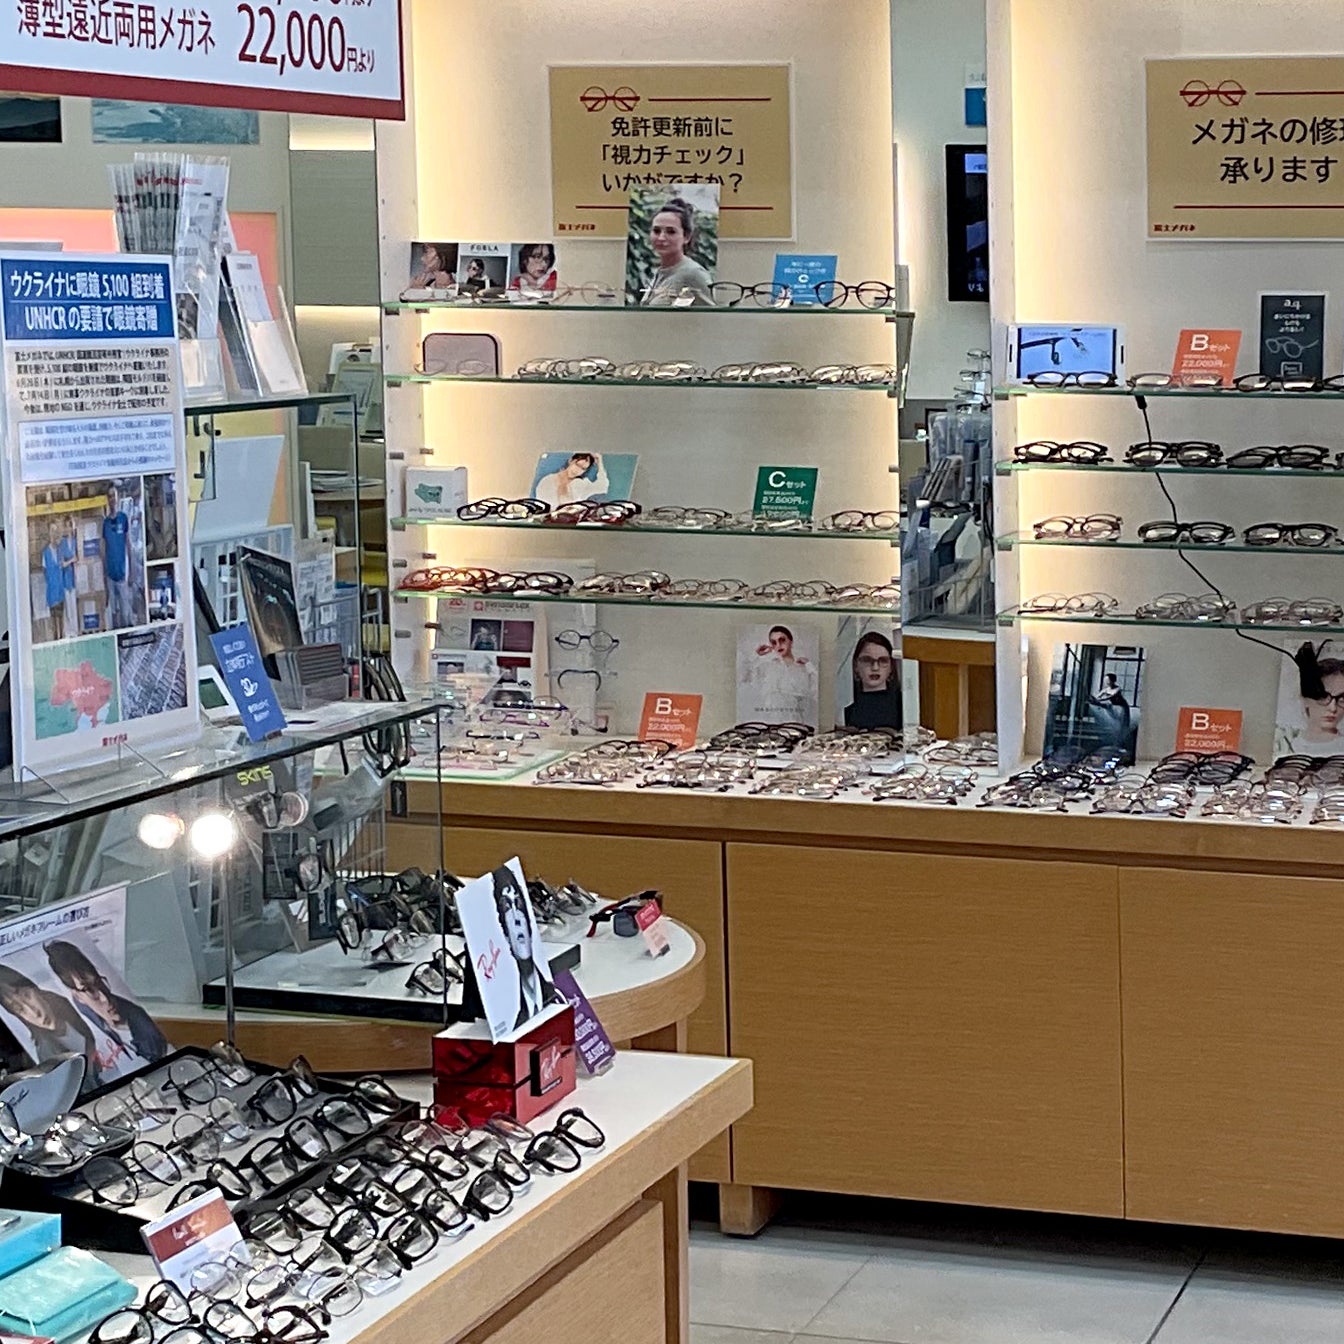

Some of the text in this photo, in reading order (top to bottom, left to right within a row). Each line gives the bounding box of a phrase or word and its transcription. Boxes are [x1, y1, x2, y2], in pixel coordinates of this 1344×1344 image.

[18, 0, 215, 54] 薄型遠近両用メガネ
[611, 117, 733, 137] 免許更新前に
[602, 145, 744, 165] 「視力チェック」
[1220, 156, 1339, 184] 承ります
[25, 306, 67, 330] UNHCR
[1191, 334, 1231, 351] Bセット
[768, 471, 806, 489] Cセット
[1191, 712, 1232, 731] Bセット
